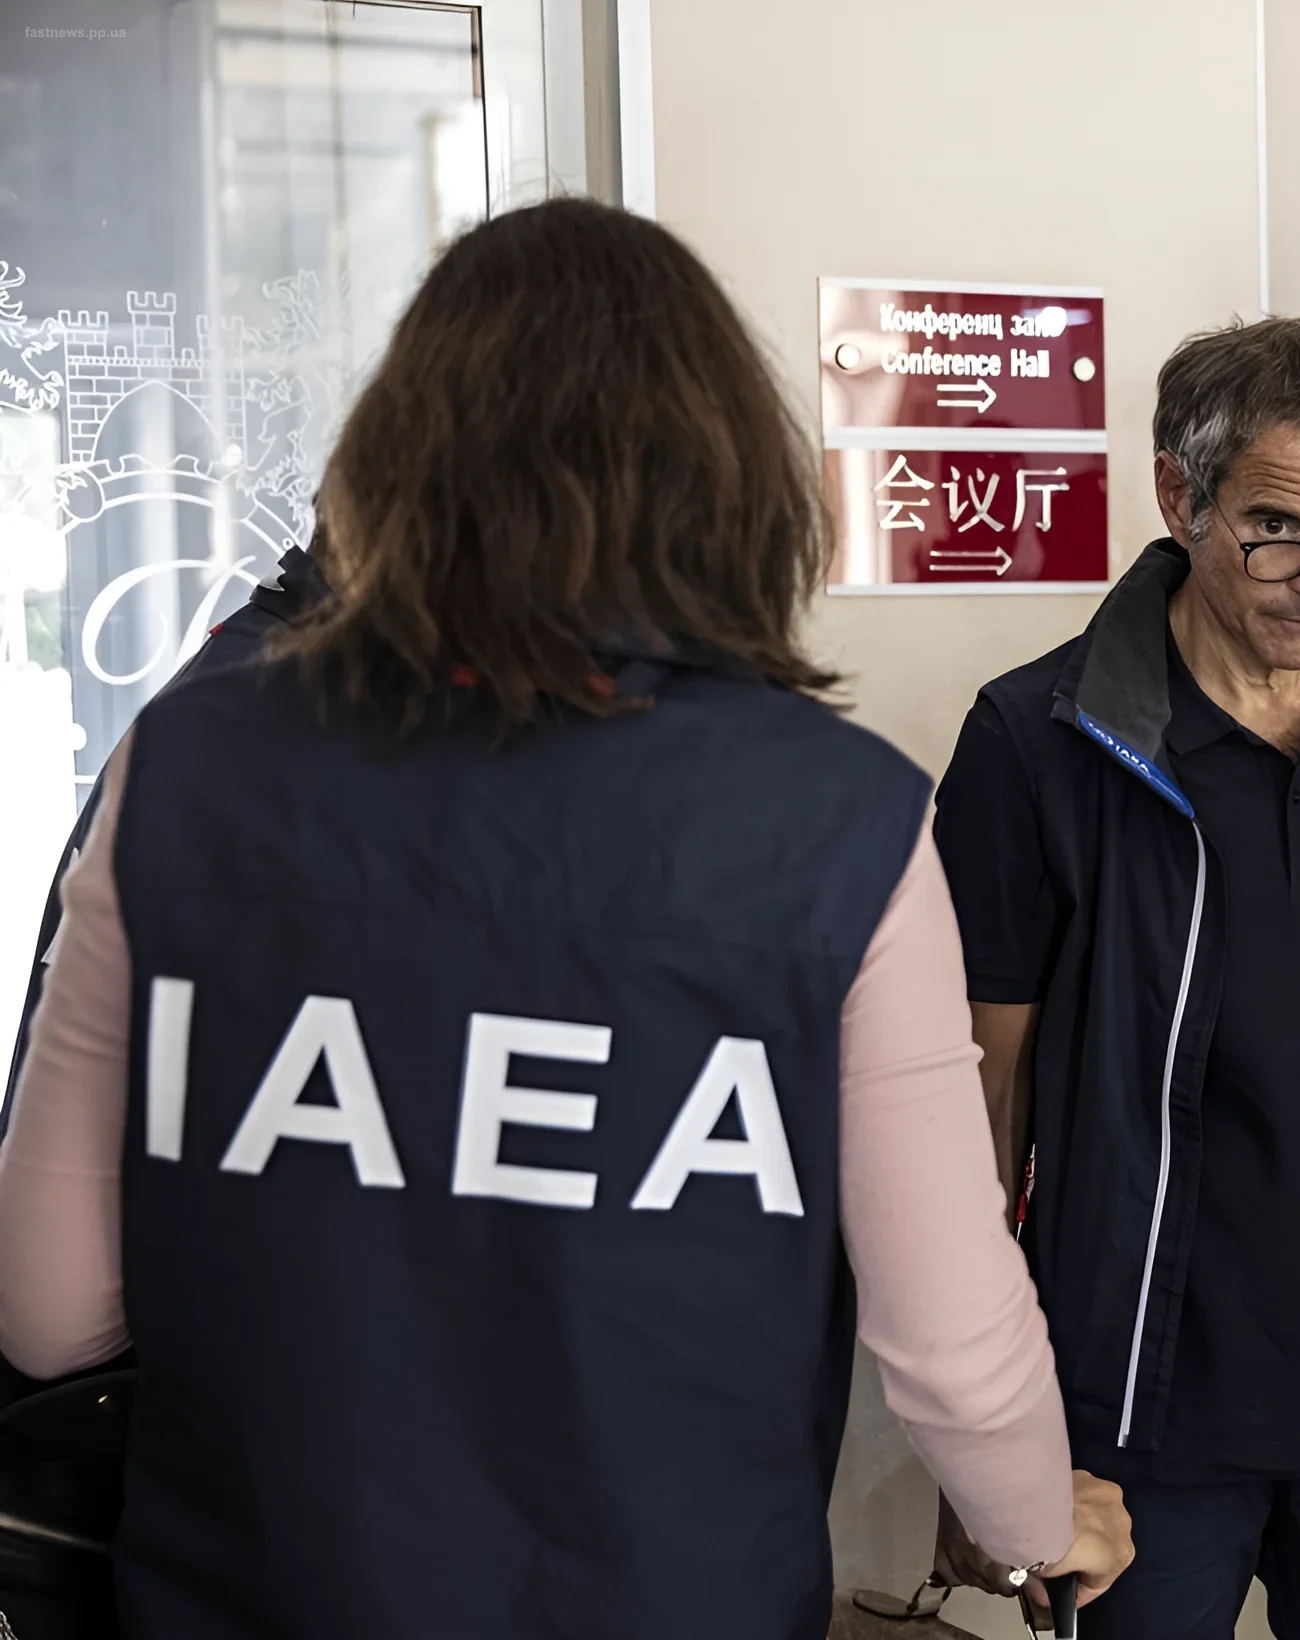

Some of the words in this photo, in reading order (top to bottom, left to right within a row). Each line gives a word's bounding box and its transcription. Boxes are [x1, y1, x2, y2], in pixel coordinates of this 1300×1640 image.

[880, 303, 1004, 341] Конференц
[1010, 313, 1062, 338] зал
[881, 346, 1002, 377] Conference
[1010, 348, 1050, 378] Hall
[873, 454, 1070, 533] 会议厅
[147, 976, 805, 1217] IAEA
